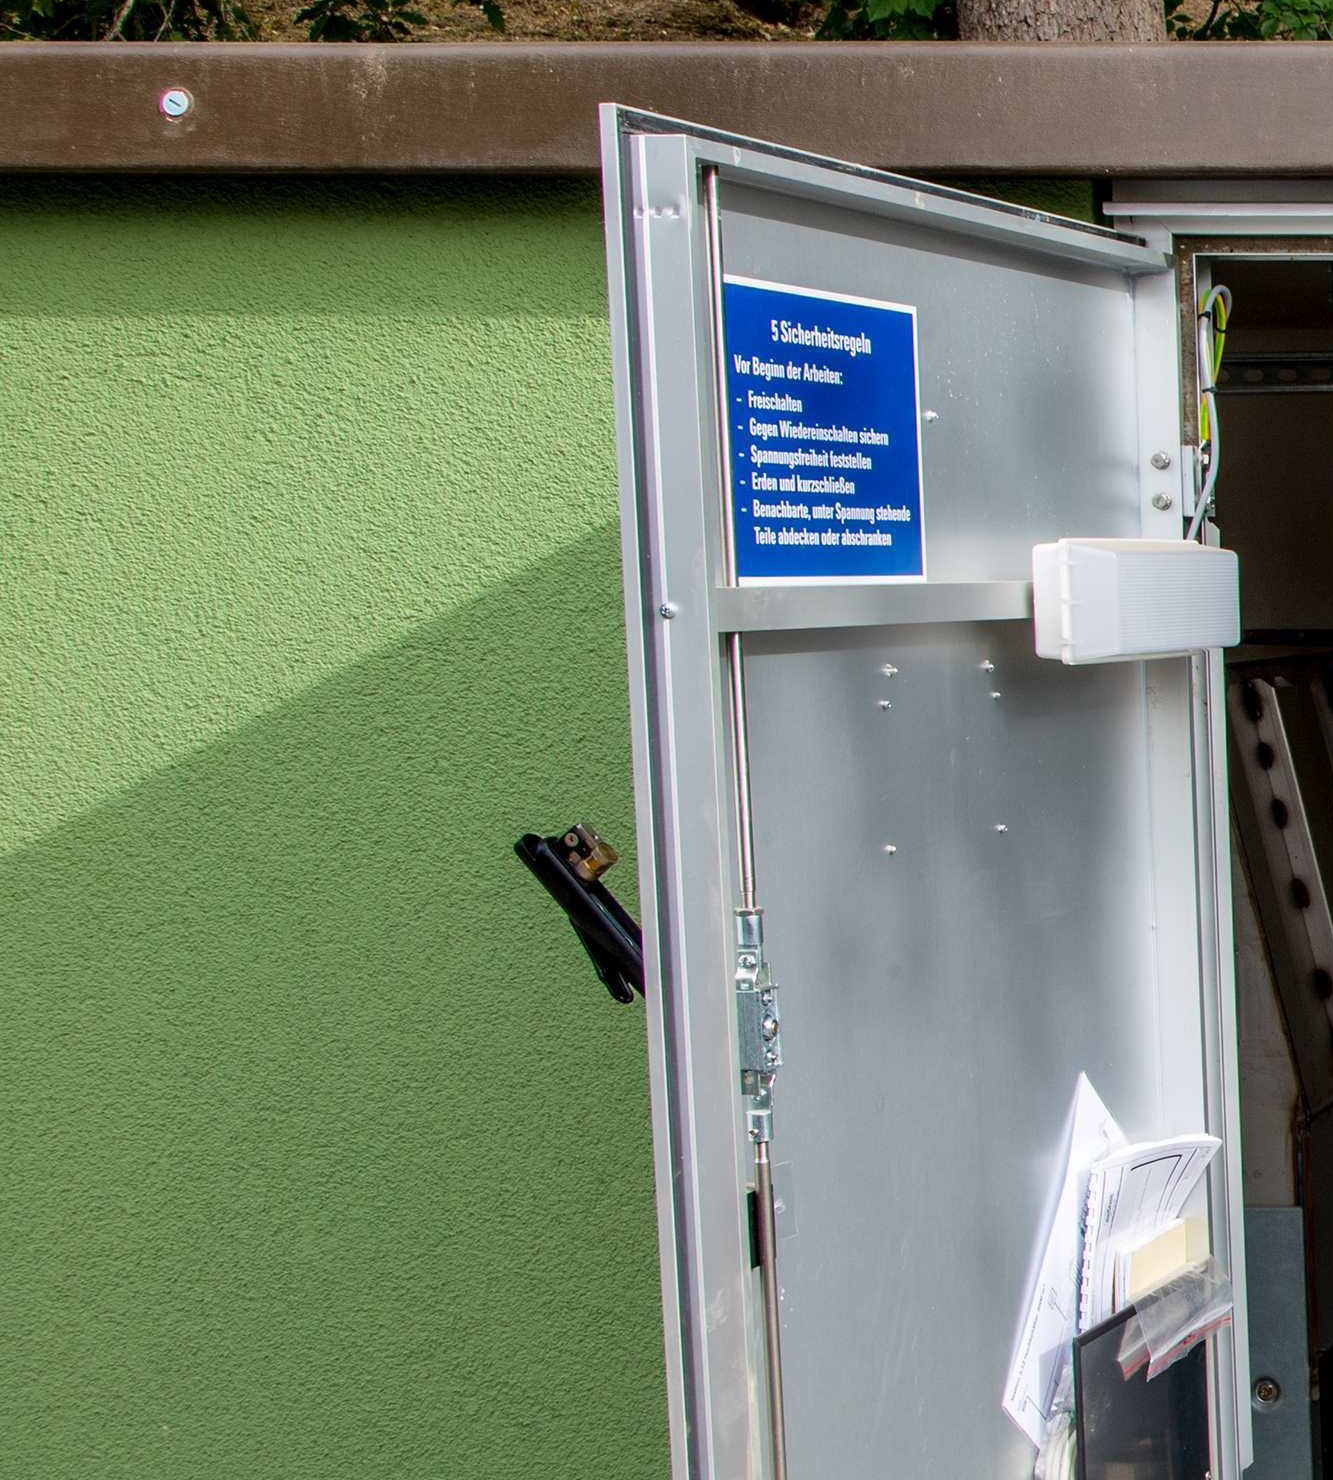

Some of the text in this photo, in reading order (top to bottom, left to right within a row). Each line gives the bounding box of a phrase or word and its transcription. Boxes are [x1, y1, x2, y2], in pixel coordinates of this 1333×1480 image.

[771, 319, 871, 357] 5 Sicherheitsregeln
[734, 354, 843, 385] Vor Beginn der Arbeiten:
[748, 390, 803, 413] Freischalten
[749, 417, 889, 446] Gegen Wiedereinschalten sichern
[751, 445, 872, 470] Spannungsfreiheit feststellen
[751, 472, 855, 495] Erden und kurzschließen
[753, 499, 911, 524] Benachbarte, unter Spannung stehende
[754, 526, 892, 546] Teile abdecken oder abschranken
